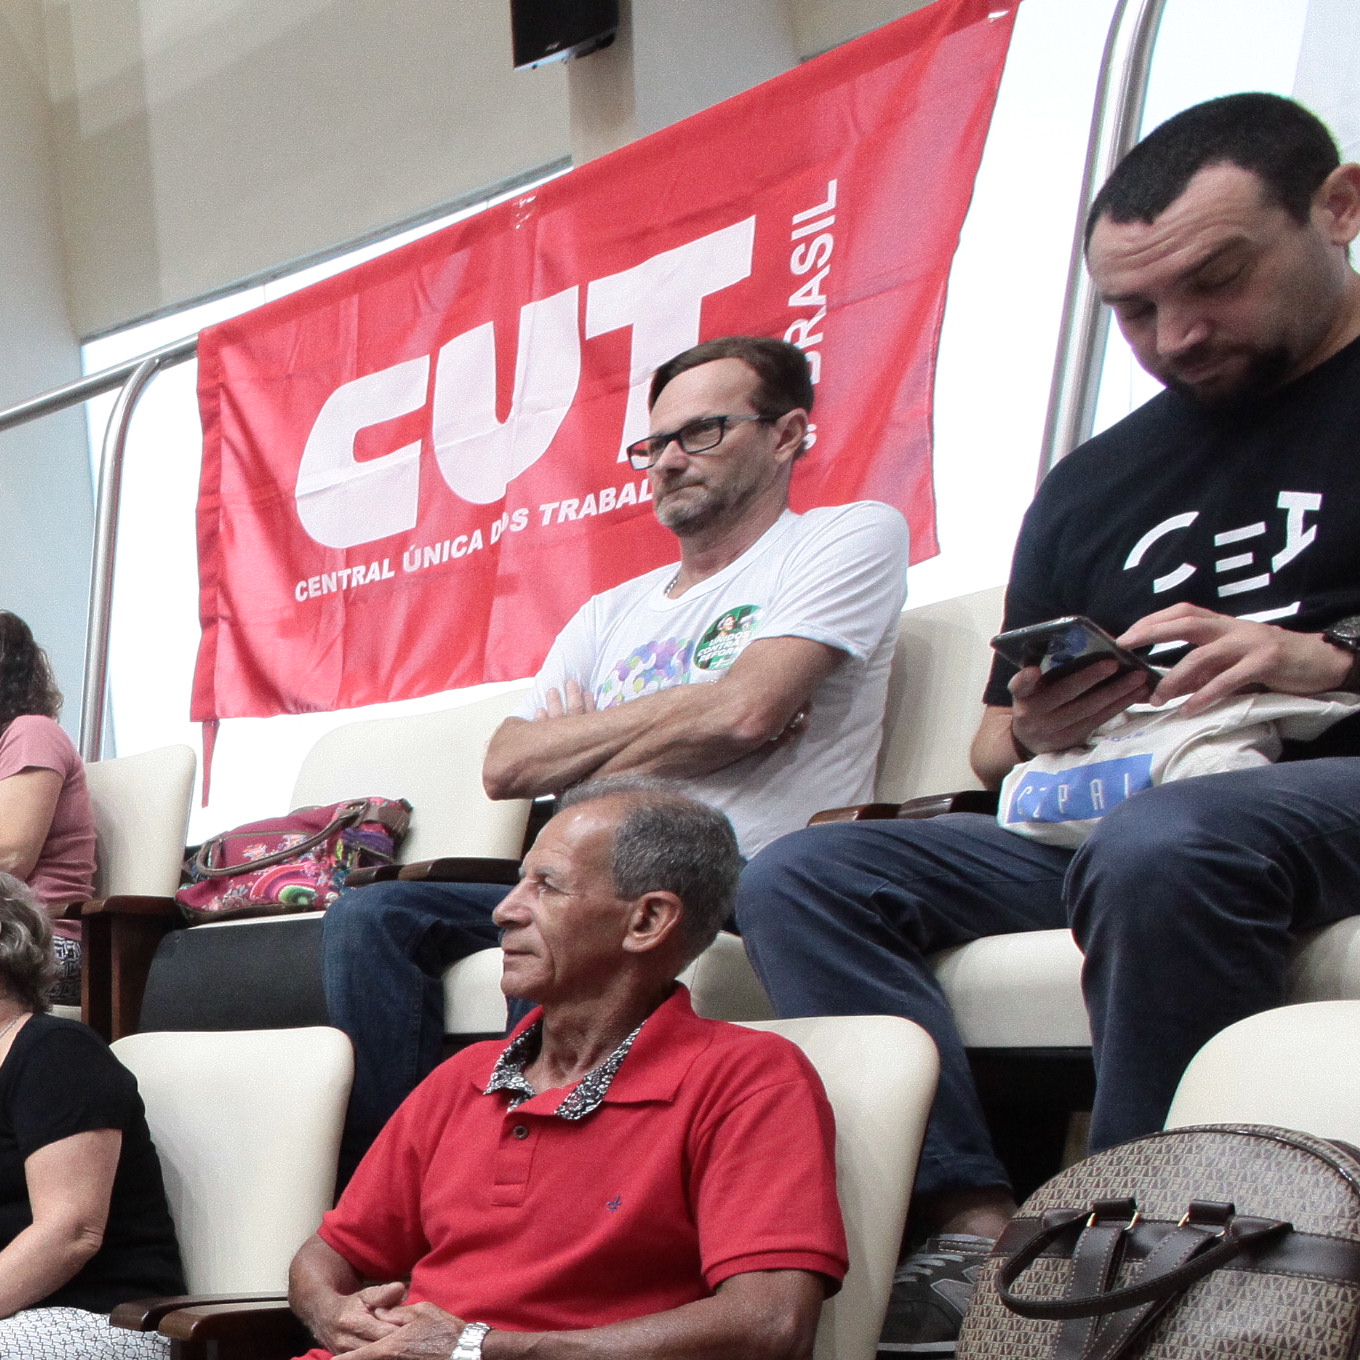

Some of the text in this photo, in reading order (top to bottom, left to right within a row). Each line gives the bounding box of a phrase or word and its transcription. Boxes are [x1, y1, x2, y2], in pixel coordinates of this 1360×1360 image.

[295, 215, 756, 549] CUT
[295, 558, 395, 602] CENTRAL
[402, 529, 482, 573] ÚNICA
